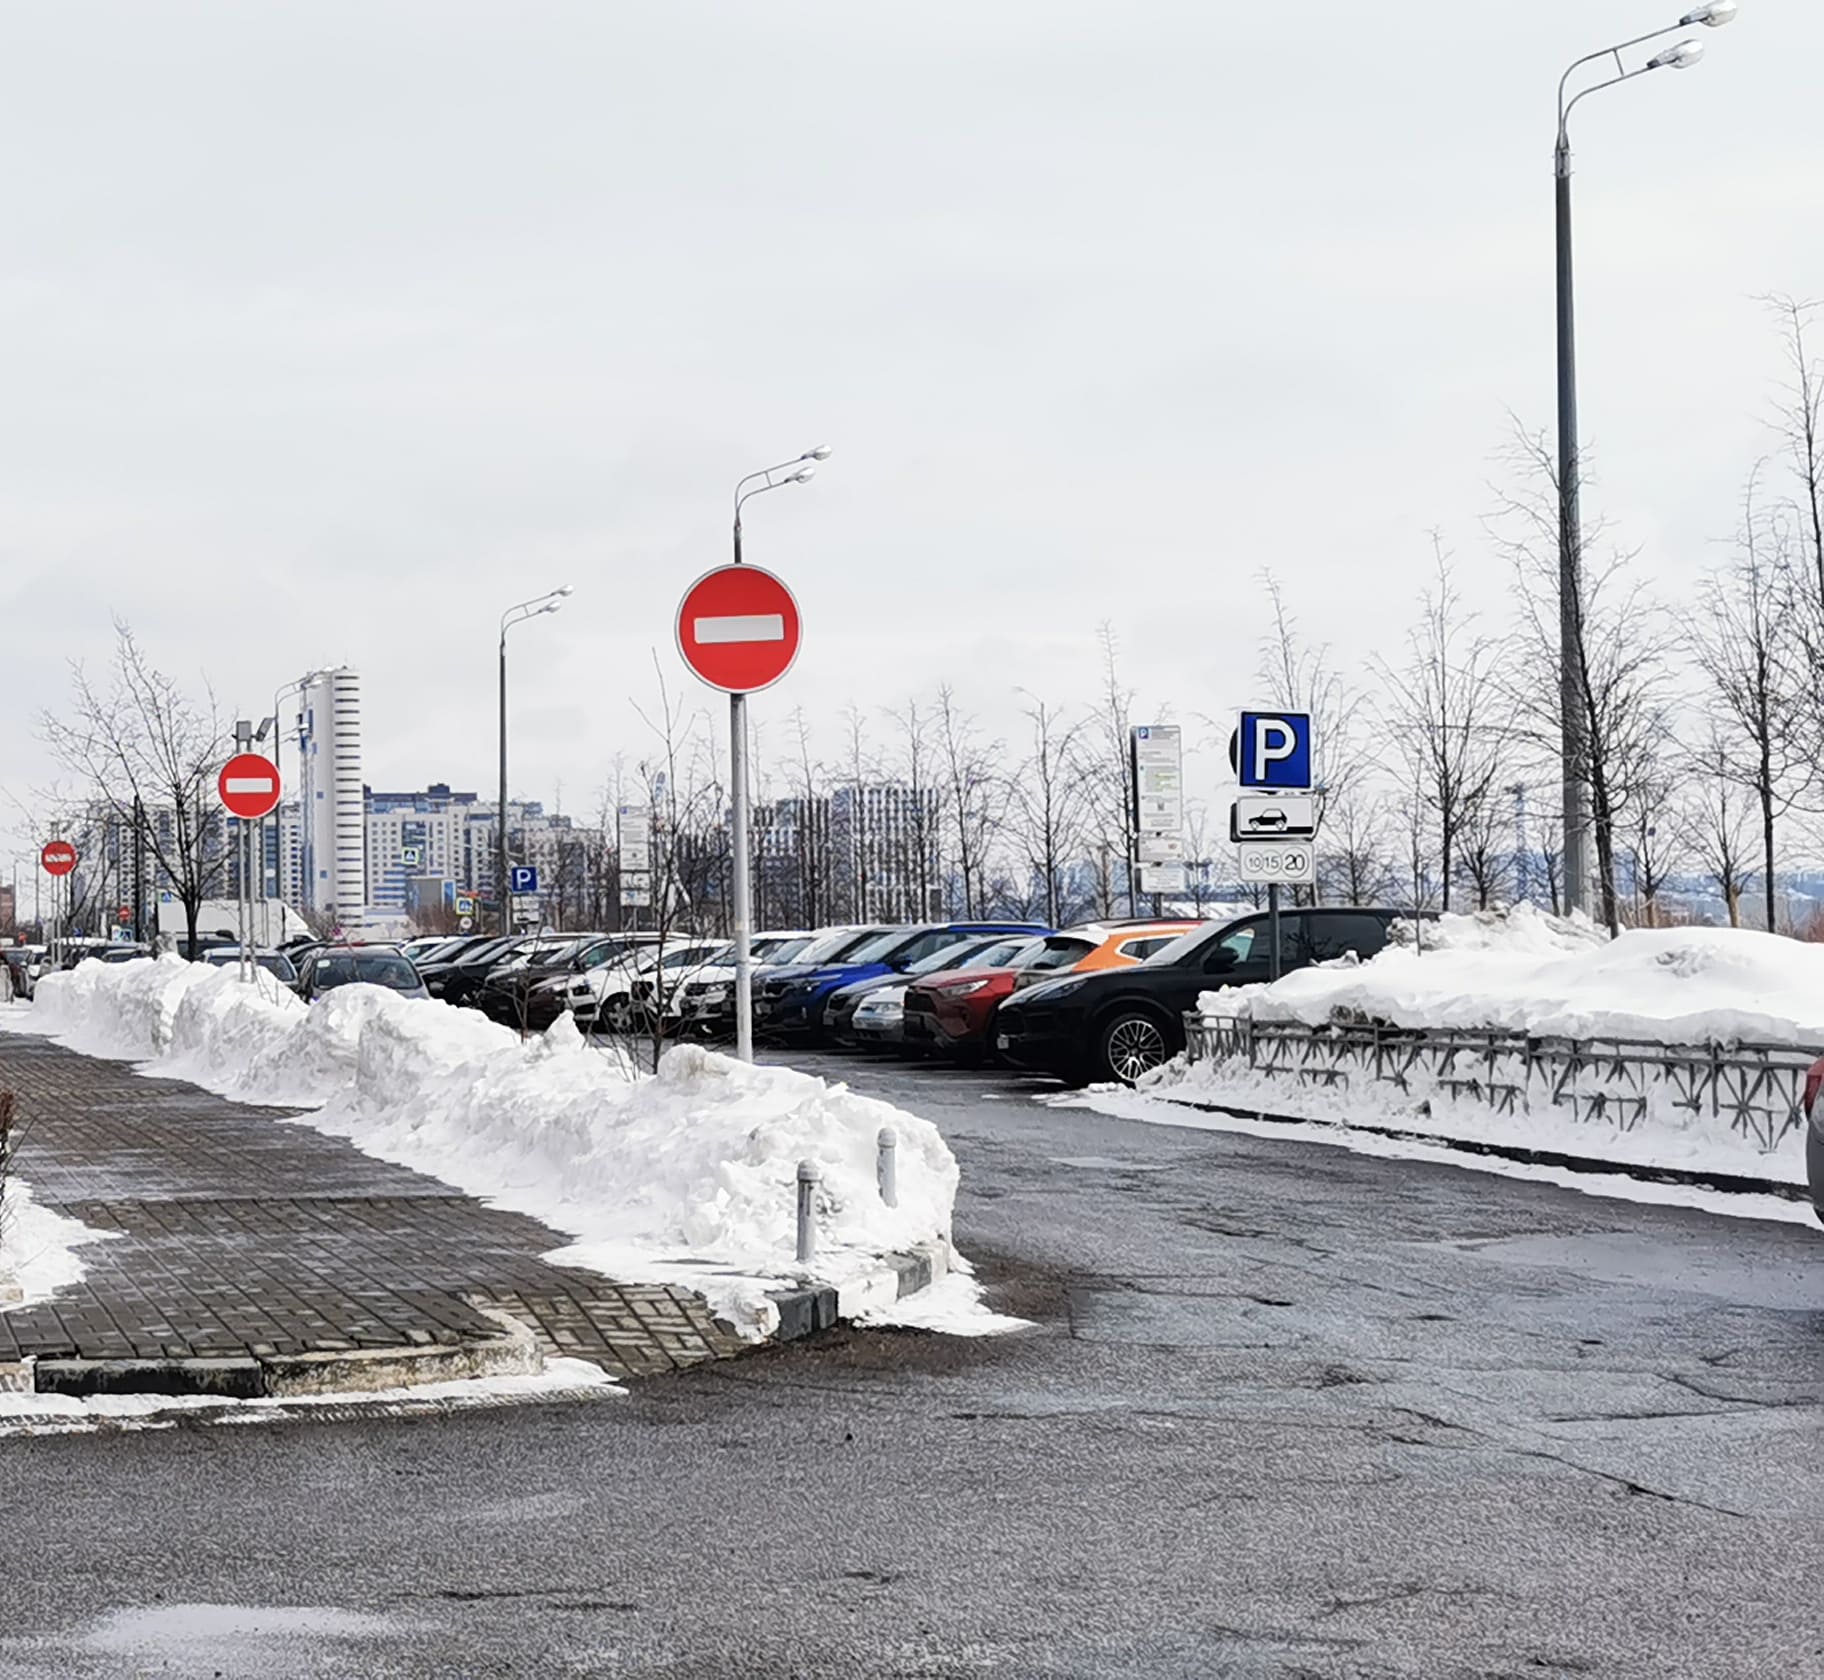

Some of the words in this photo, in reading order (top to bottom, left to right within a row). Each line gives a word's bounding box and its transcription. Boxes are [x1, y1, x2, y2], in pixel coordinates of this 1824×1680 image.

[1255, 718, 1297, 781] P
[1249, 856, 1262, 868] 10
[1264, 855, 1279, 869] 15
[1284, 854, 1305, 871] 20
[516, 868, 532, 890] P
